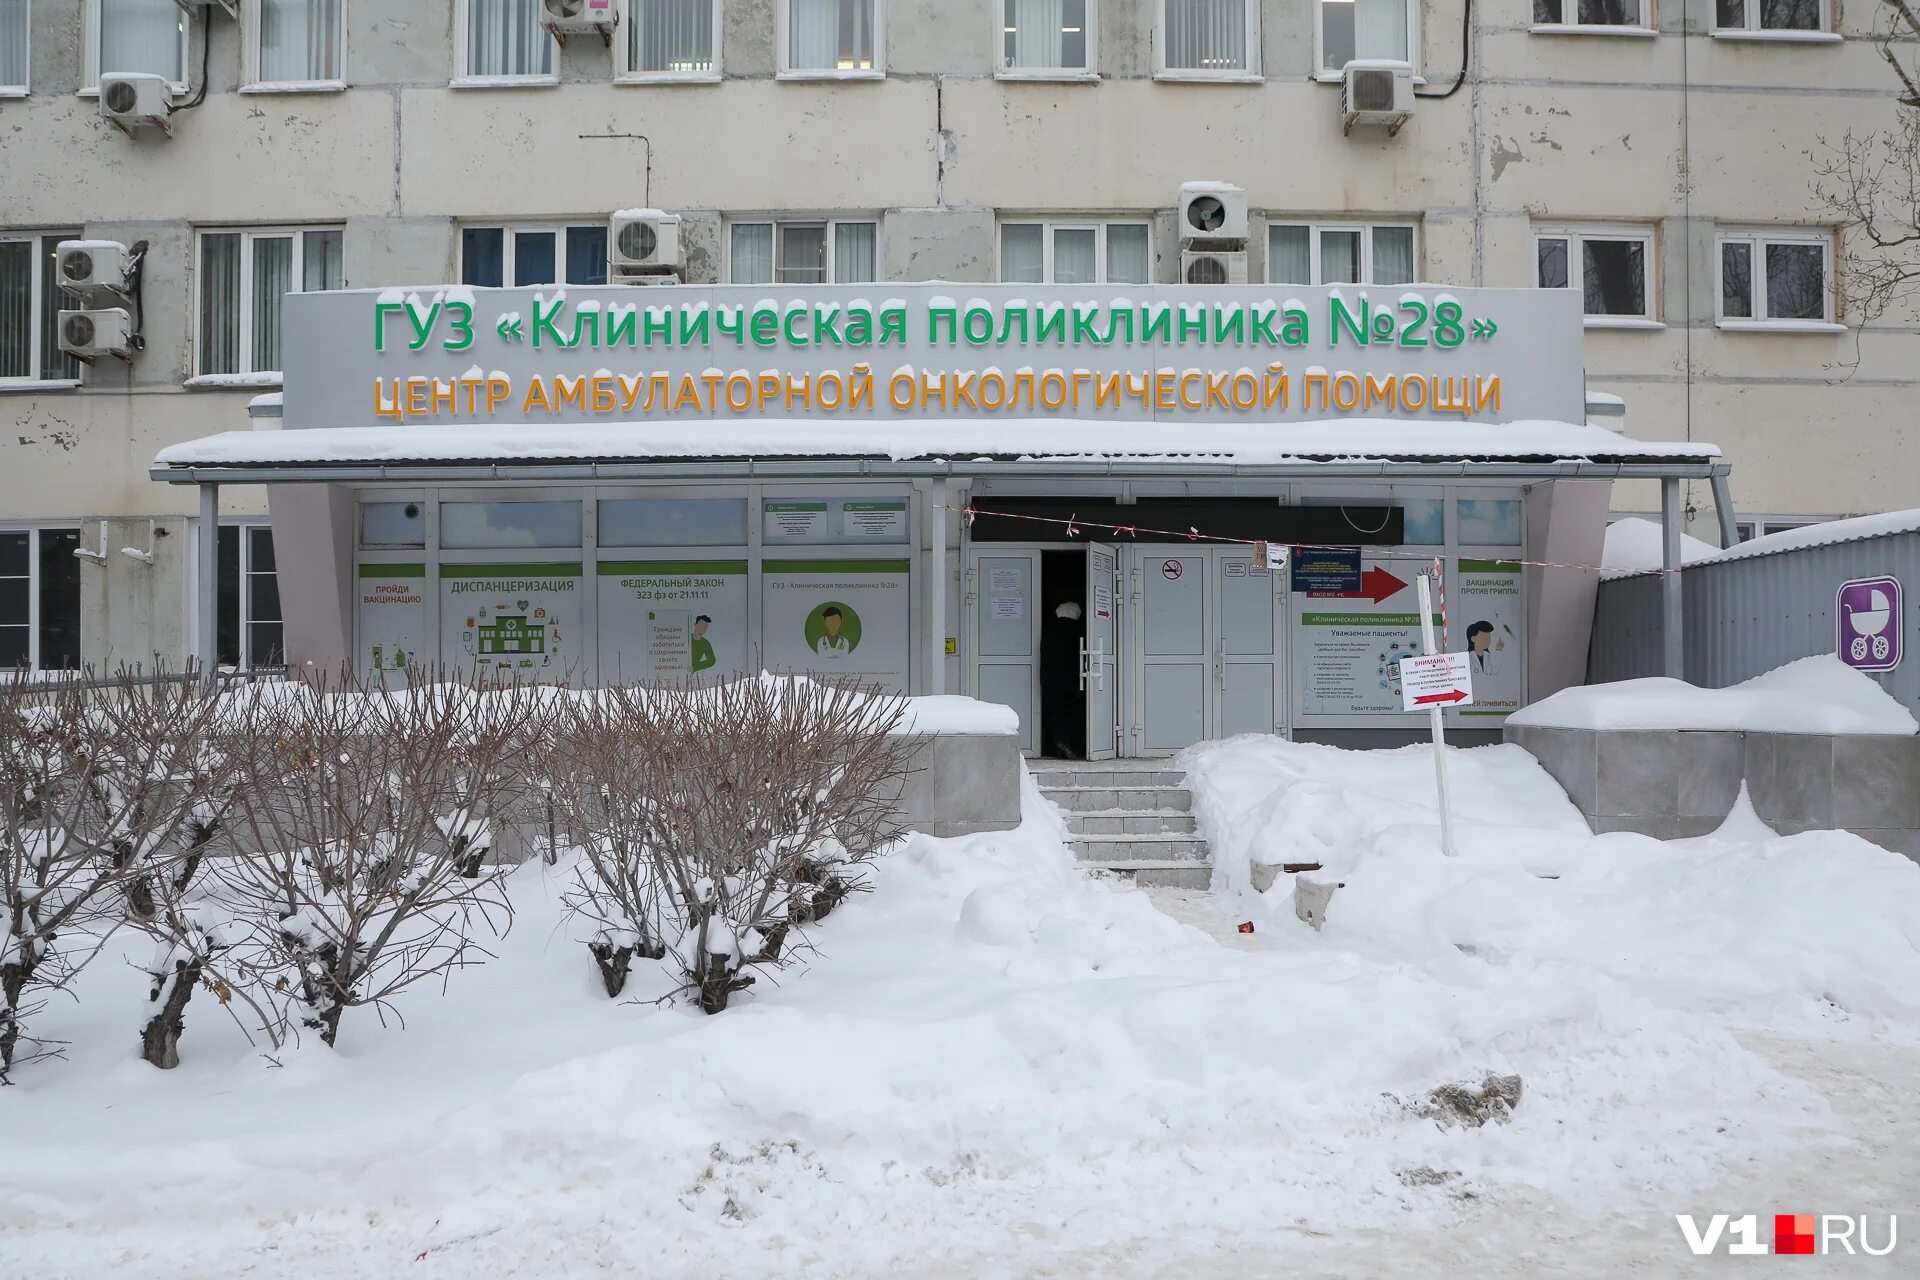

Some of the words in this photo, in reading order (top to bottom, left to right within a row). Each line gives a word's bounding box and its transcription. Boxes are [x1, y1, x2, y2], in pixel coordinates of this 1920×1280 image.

[375, 297, 475, 350] ГУЗ
[496, 298, 907, 349] «Клиническая
[928, 305, 1310, 346] поликлиника
[1329, 296, 1498, 349] №28»
[375, 374, 511, 421] ЦЕНТР
[522, 364, 874, 413] АМБУЛАТОРНОЙ
[889, 363, 1290, 410] ОНКОЛОГИЧЕСКОЙ
[1303, 373, 1501, 417] ПОМОЩИ
[452, 581, 574, 593] ДИСПАНЦЕРИЗАЦИЯ
[621, 578, 691, 588] ФЕДЕРАЛЬНЫЙ
[694, 579, 724, 587] ЗАКОН
[376, 585, 409, 594] ПРОЙДИ
[364, 596, 421, 604] ВАКЦИНАЦИЮ
[654, 591, 666, 600] фз
[680, 591, 708, 599] 21.11.11
